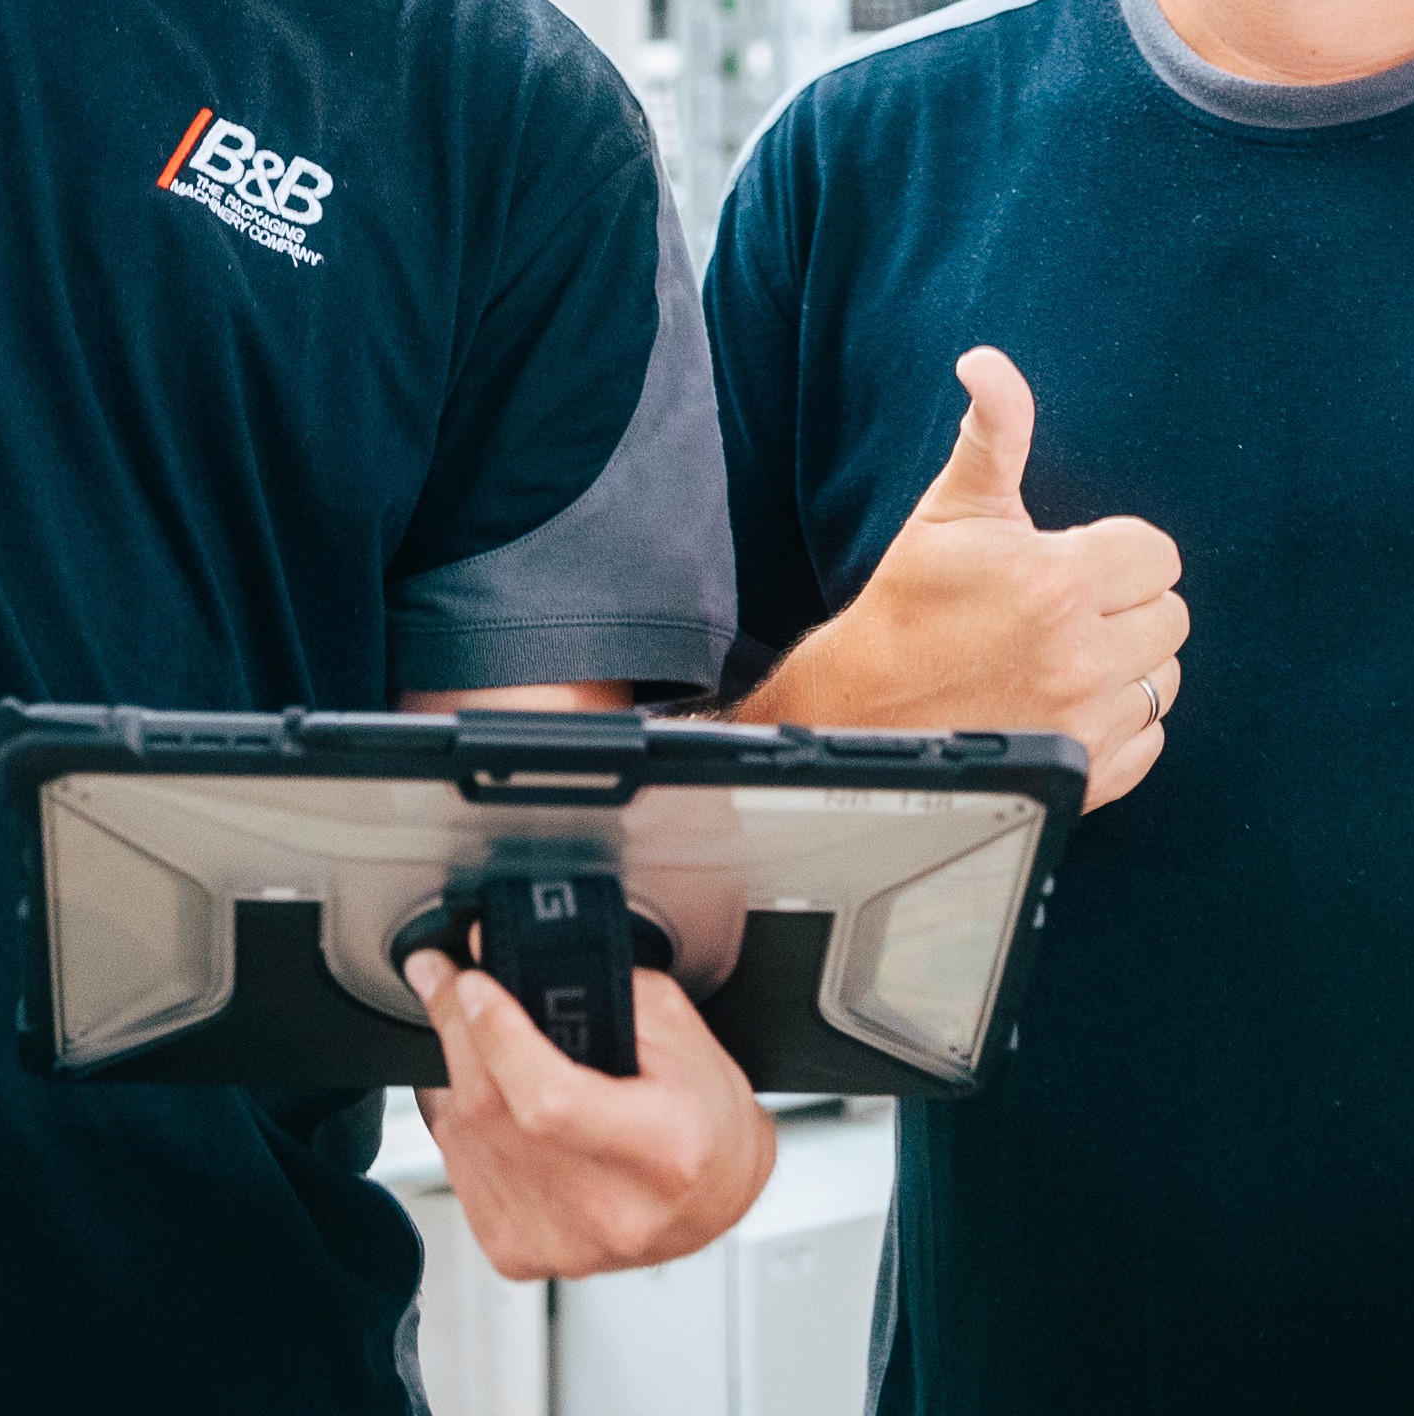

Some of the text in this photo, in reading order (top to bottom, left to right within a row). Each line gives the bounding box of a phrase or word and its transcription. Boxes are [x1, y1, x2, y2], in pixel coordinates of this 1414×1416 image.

[189, 117, 333, 225] B&B
[196, 174, 306, 243] THE PACKAGING
[169, 178, 325, 268] MACHINERY COMPANY
